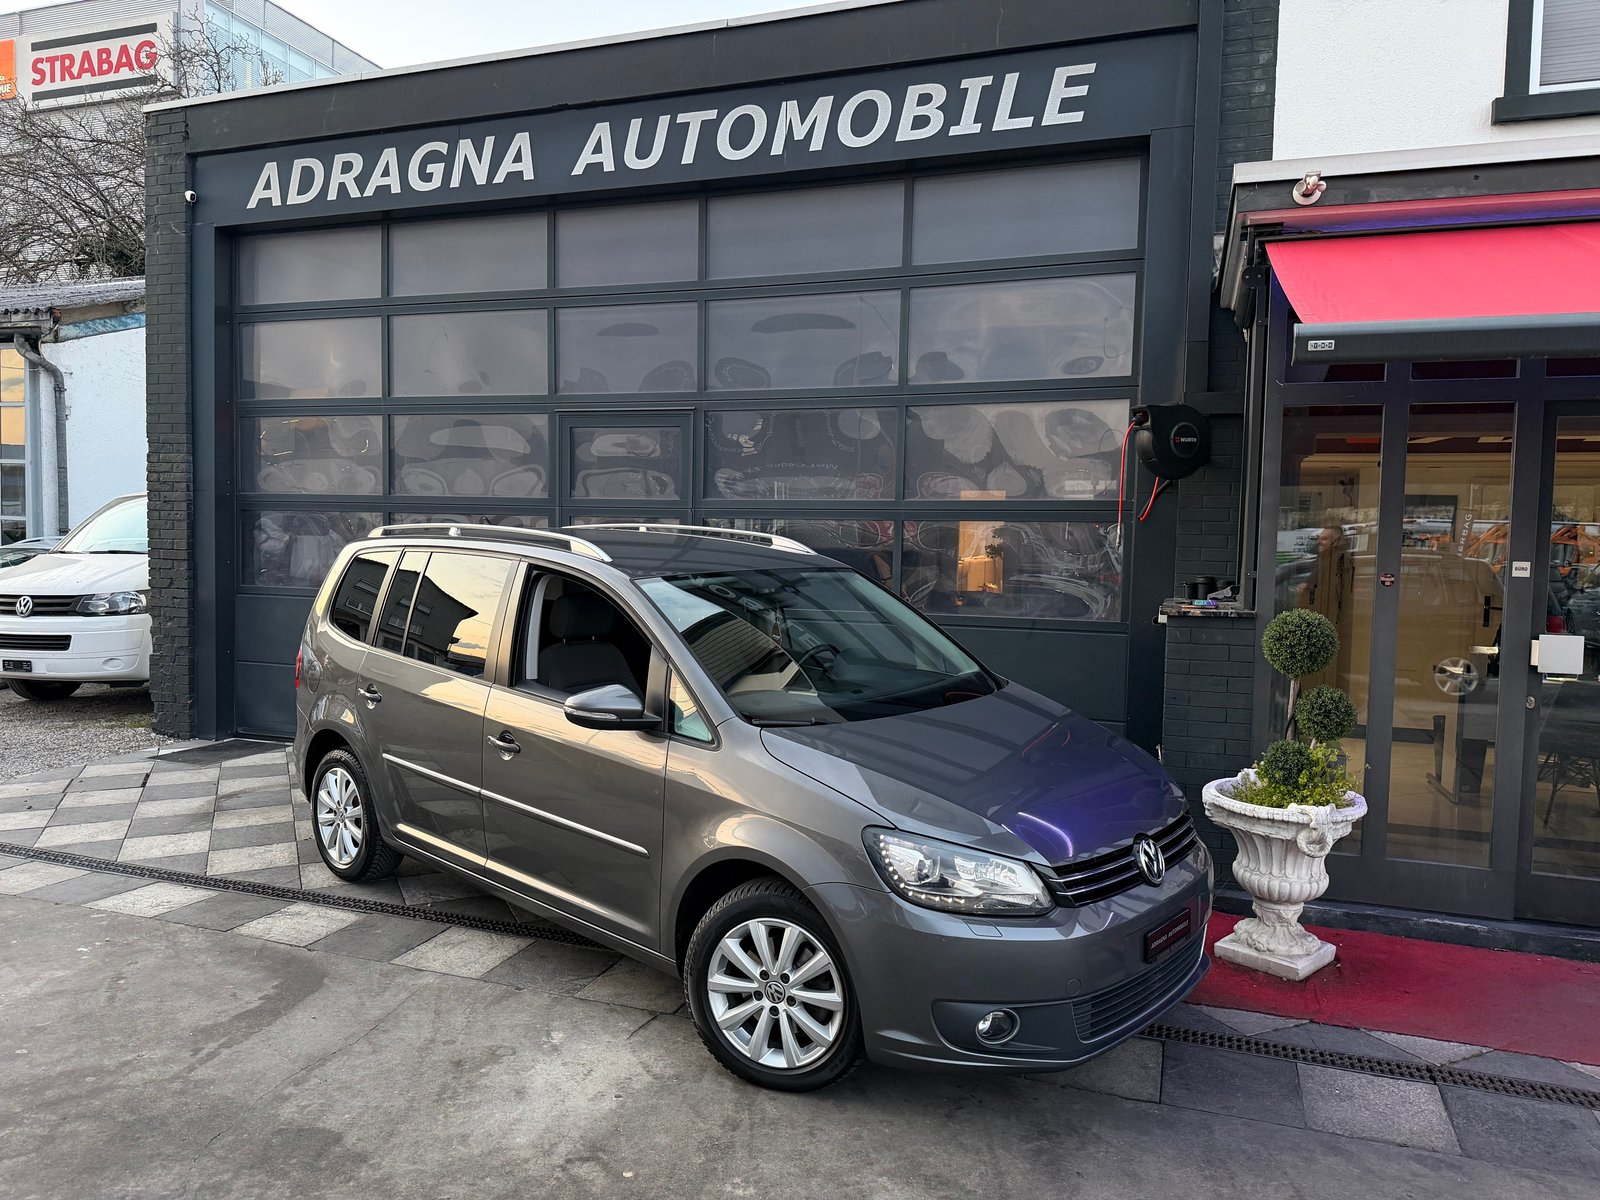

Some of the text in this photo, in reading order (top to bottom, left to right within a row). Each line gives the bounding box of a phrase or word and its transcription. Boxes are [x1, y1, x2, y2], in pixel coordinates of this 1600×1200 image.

[31, 40, 157, 86] STRABAG
[246, 62, 1097, 210] ADRAGNA AUTOMOBILE
